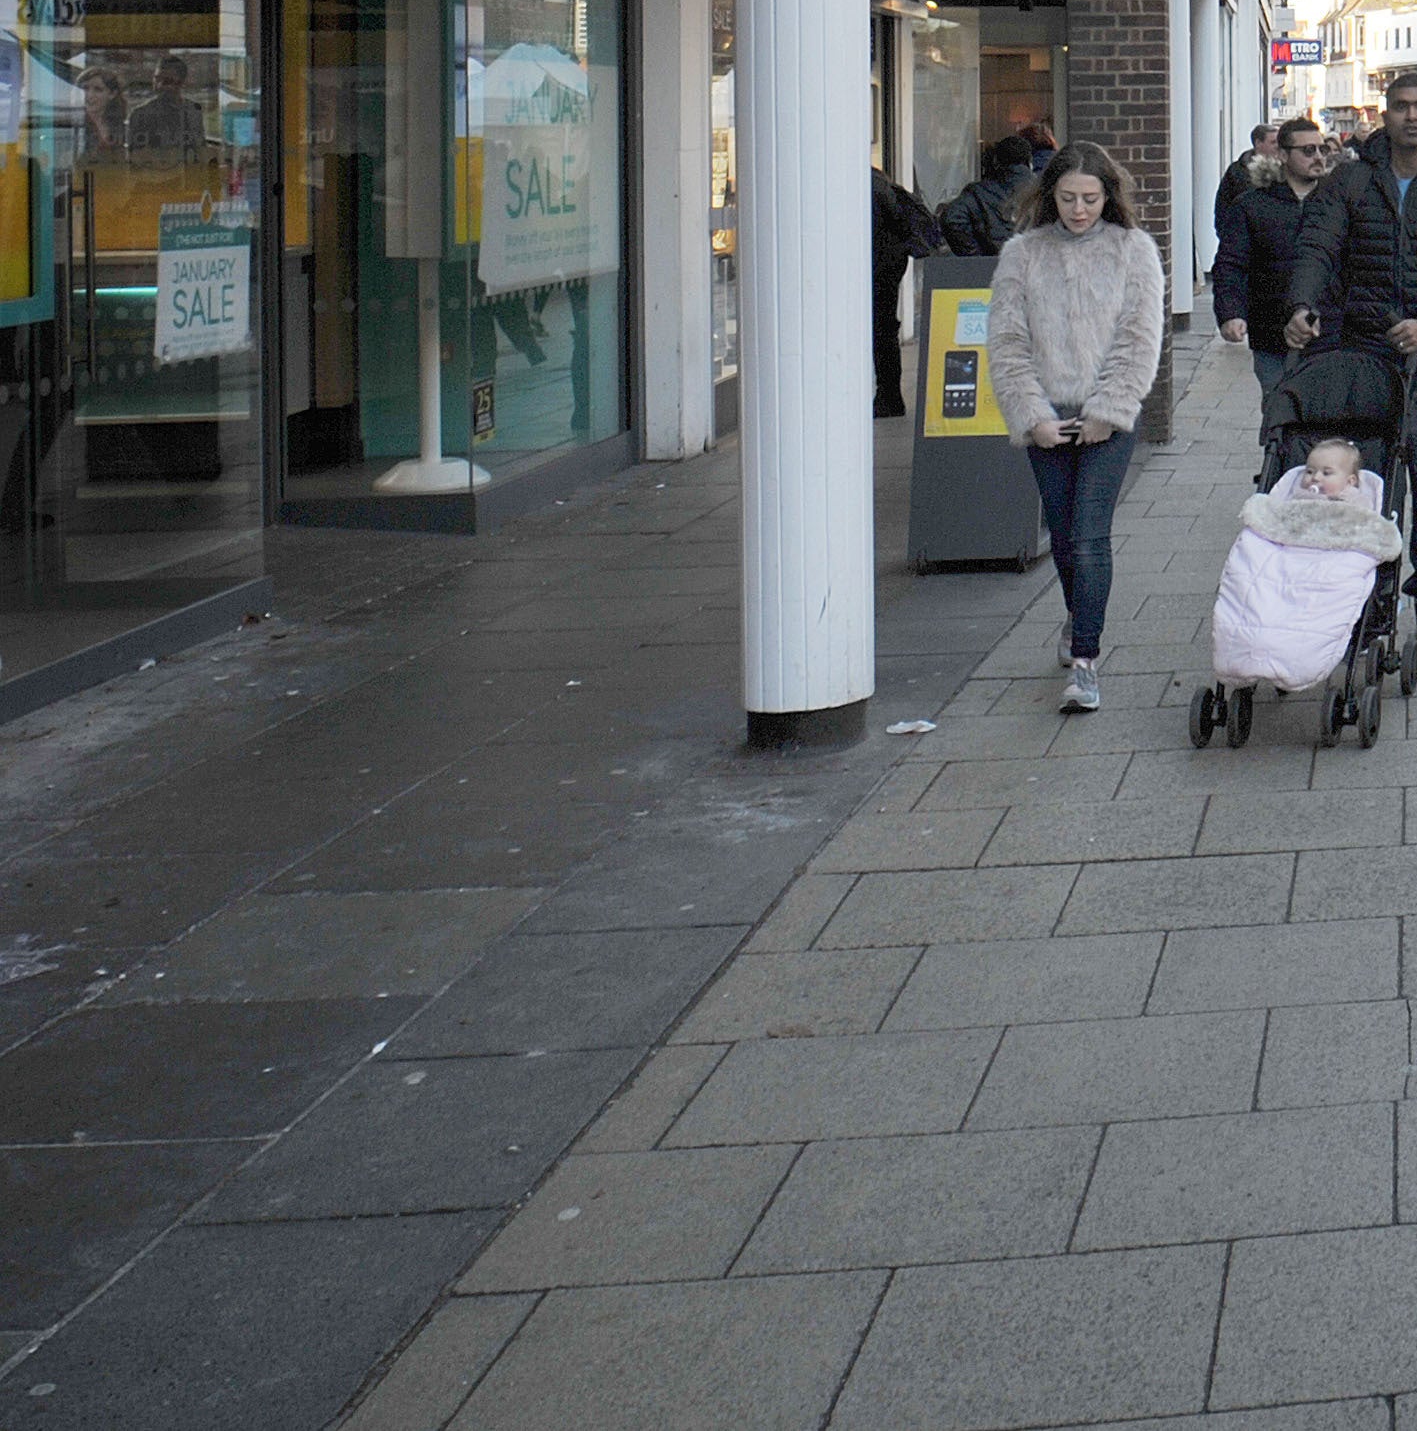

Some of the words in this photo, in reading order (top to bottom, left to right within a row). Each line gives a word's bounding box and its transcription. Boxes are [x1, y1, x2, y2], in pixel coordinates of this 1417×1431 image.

[1272, 41, 1320, 63] METRO
[504, 82, 600, 125] JANUARY
[505, 154, 577, 220] SALE
[172, 257, 237, 285] JANUARY
[172, 282, 235, 330] SALE
